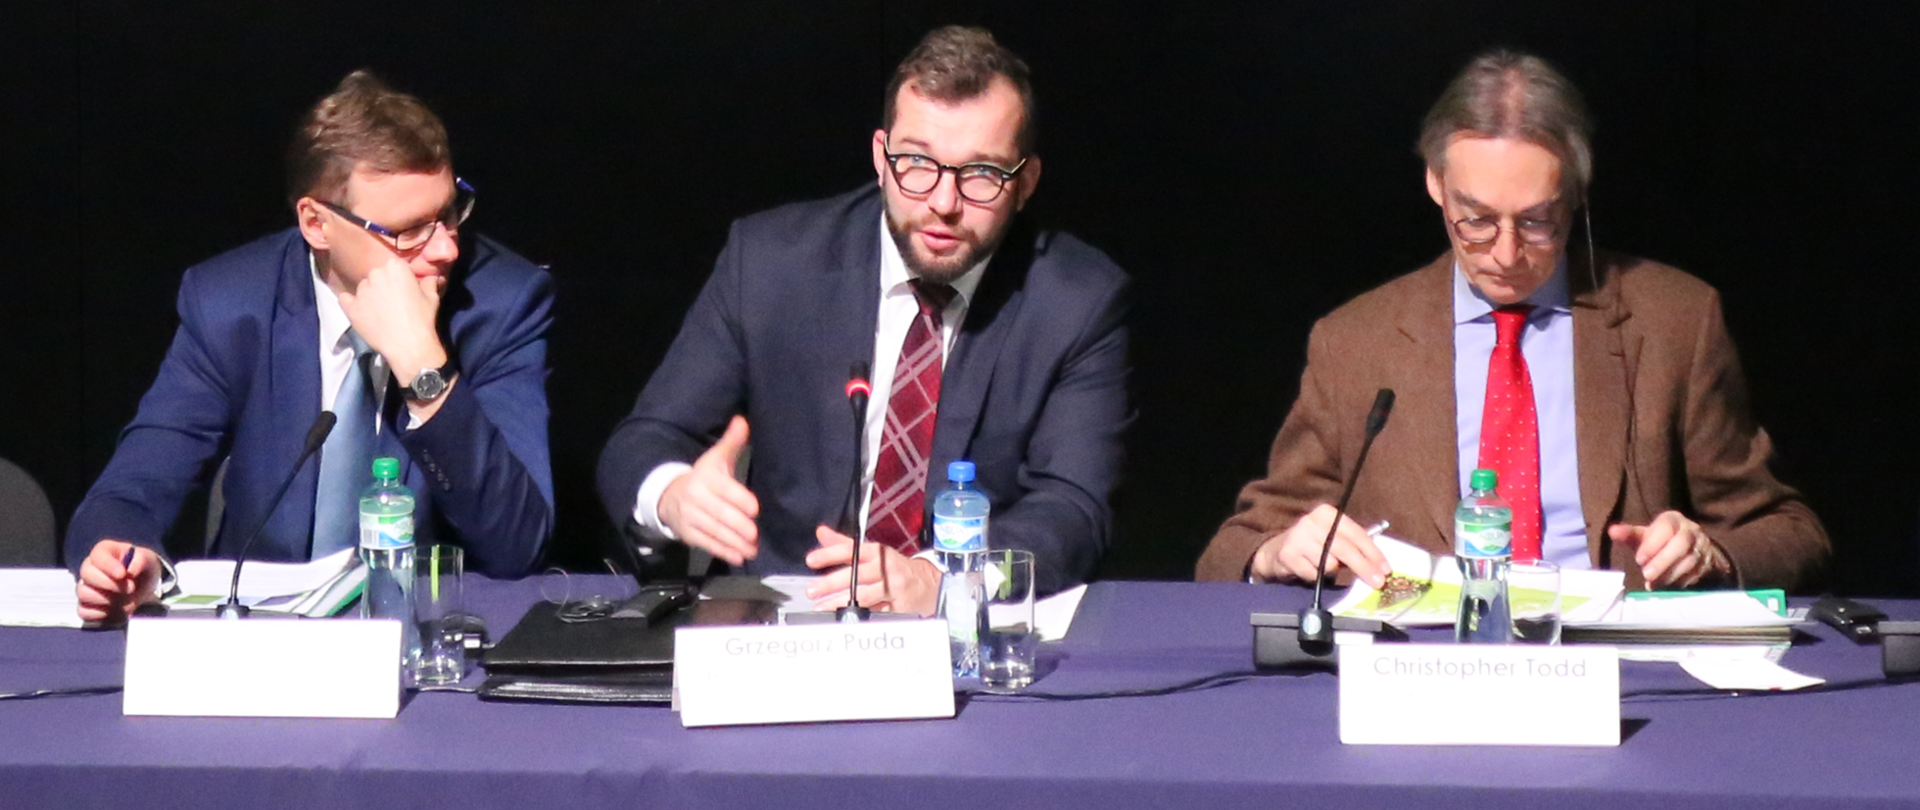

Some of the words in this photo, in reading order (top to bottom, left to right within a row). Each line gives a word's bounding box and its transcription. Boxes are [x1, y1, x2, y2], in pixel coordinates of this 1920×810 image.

[725, 637, 834, 658] Grzegorz
[844, 632, 905, 651] Puda
[1373, 656, 1516, 680] Christopher
[1525, 658, 1587, 677] Todd
